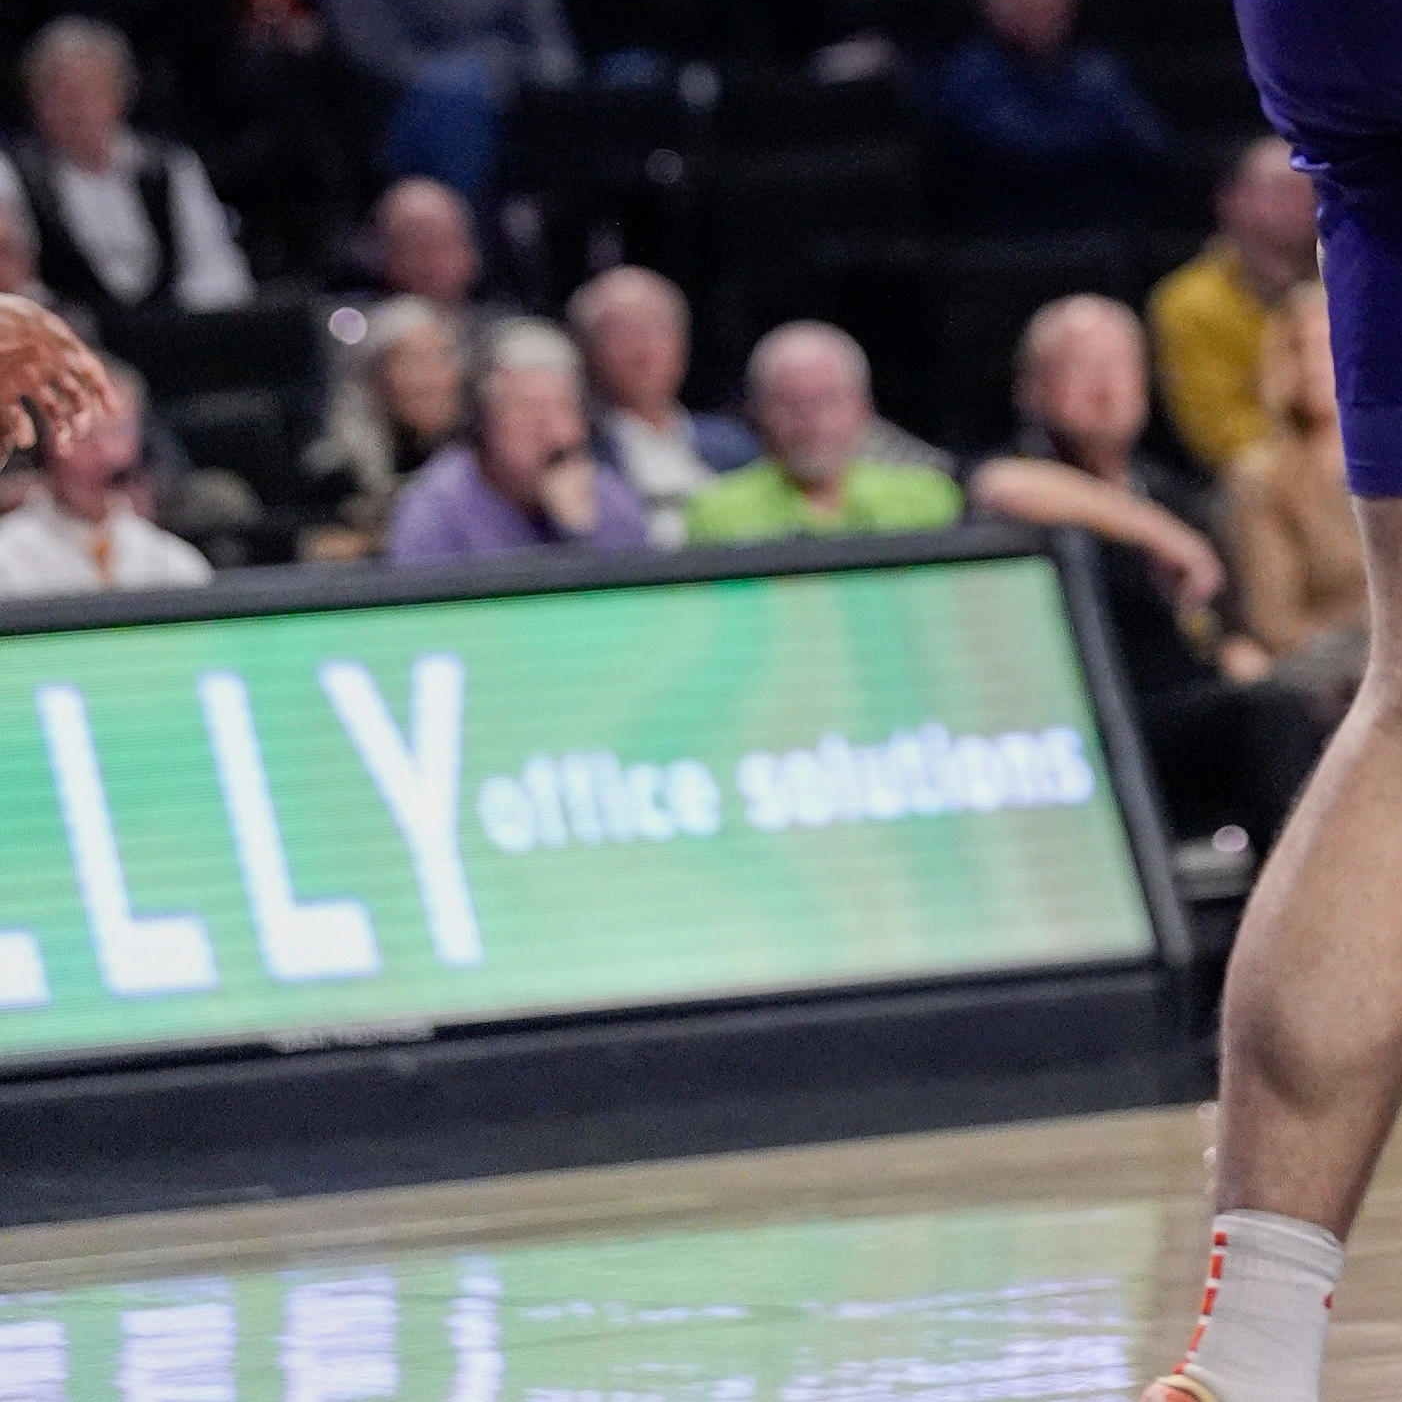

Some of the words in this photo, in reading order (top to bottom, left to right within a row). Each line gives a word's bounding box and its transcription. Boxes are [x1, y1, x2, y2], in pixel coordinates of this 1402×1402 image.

[0, 653, 485, 1007] LLY
[475, 748, 723, 854] office
[736, 720, 1097, 831] solutions
